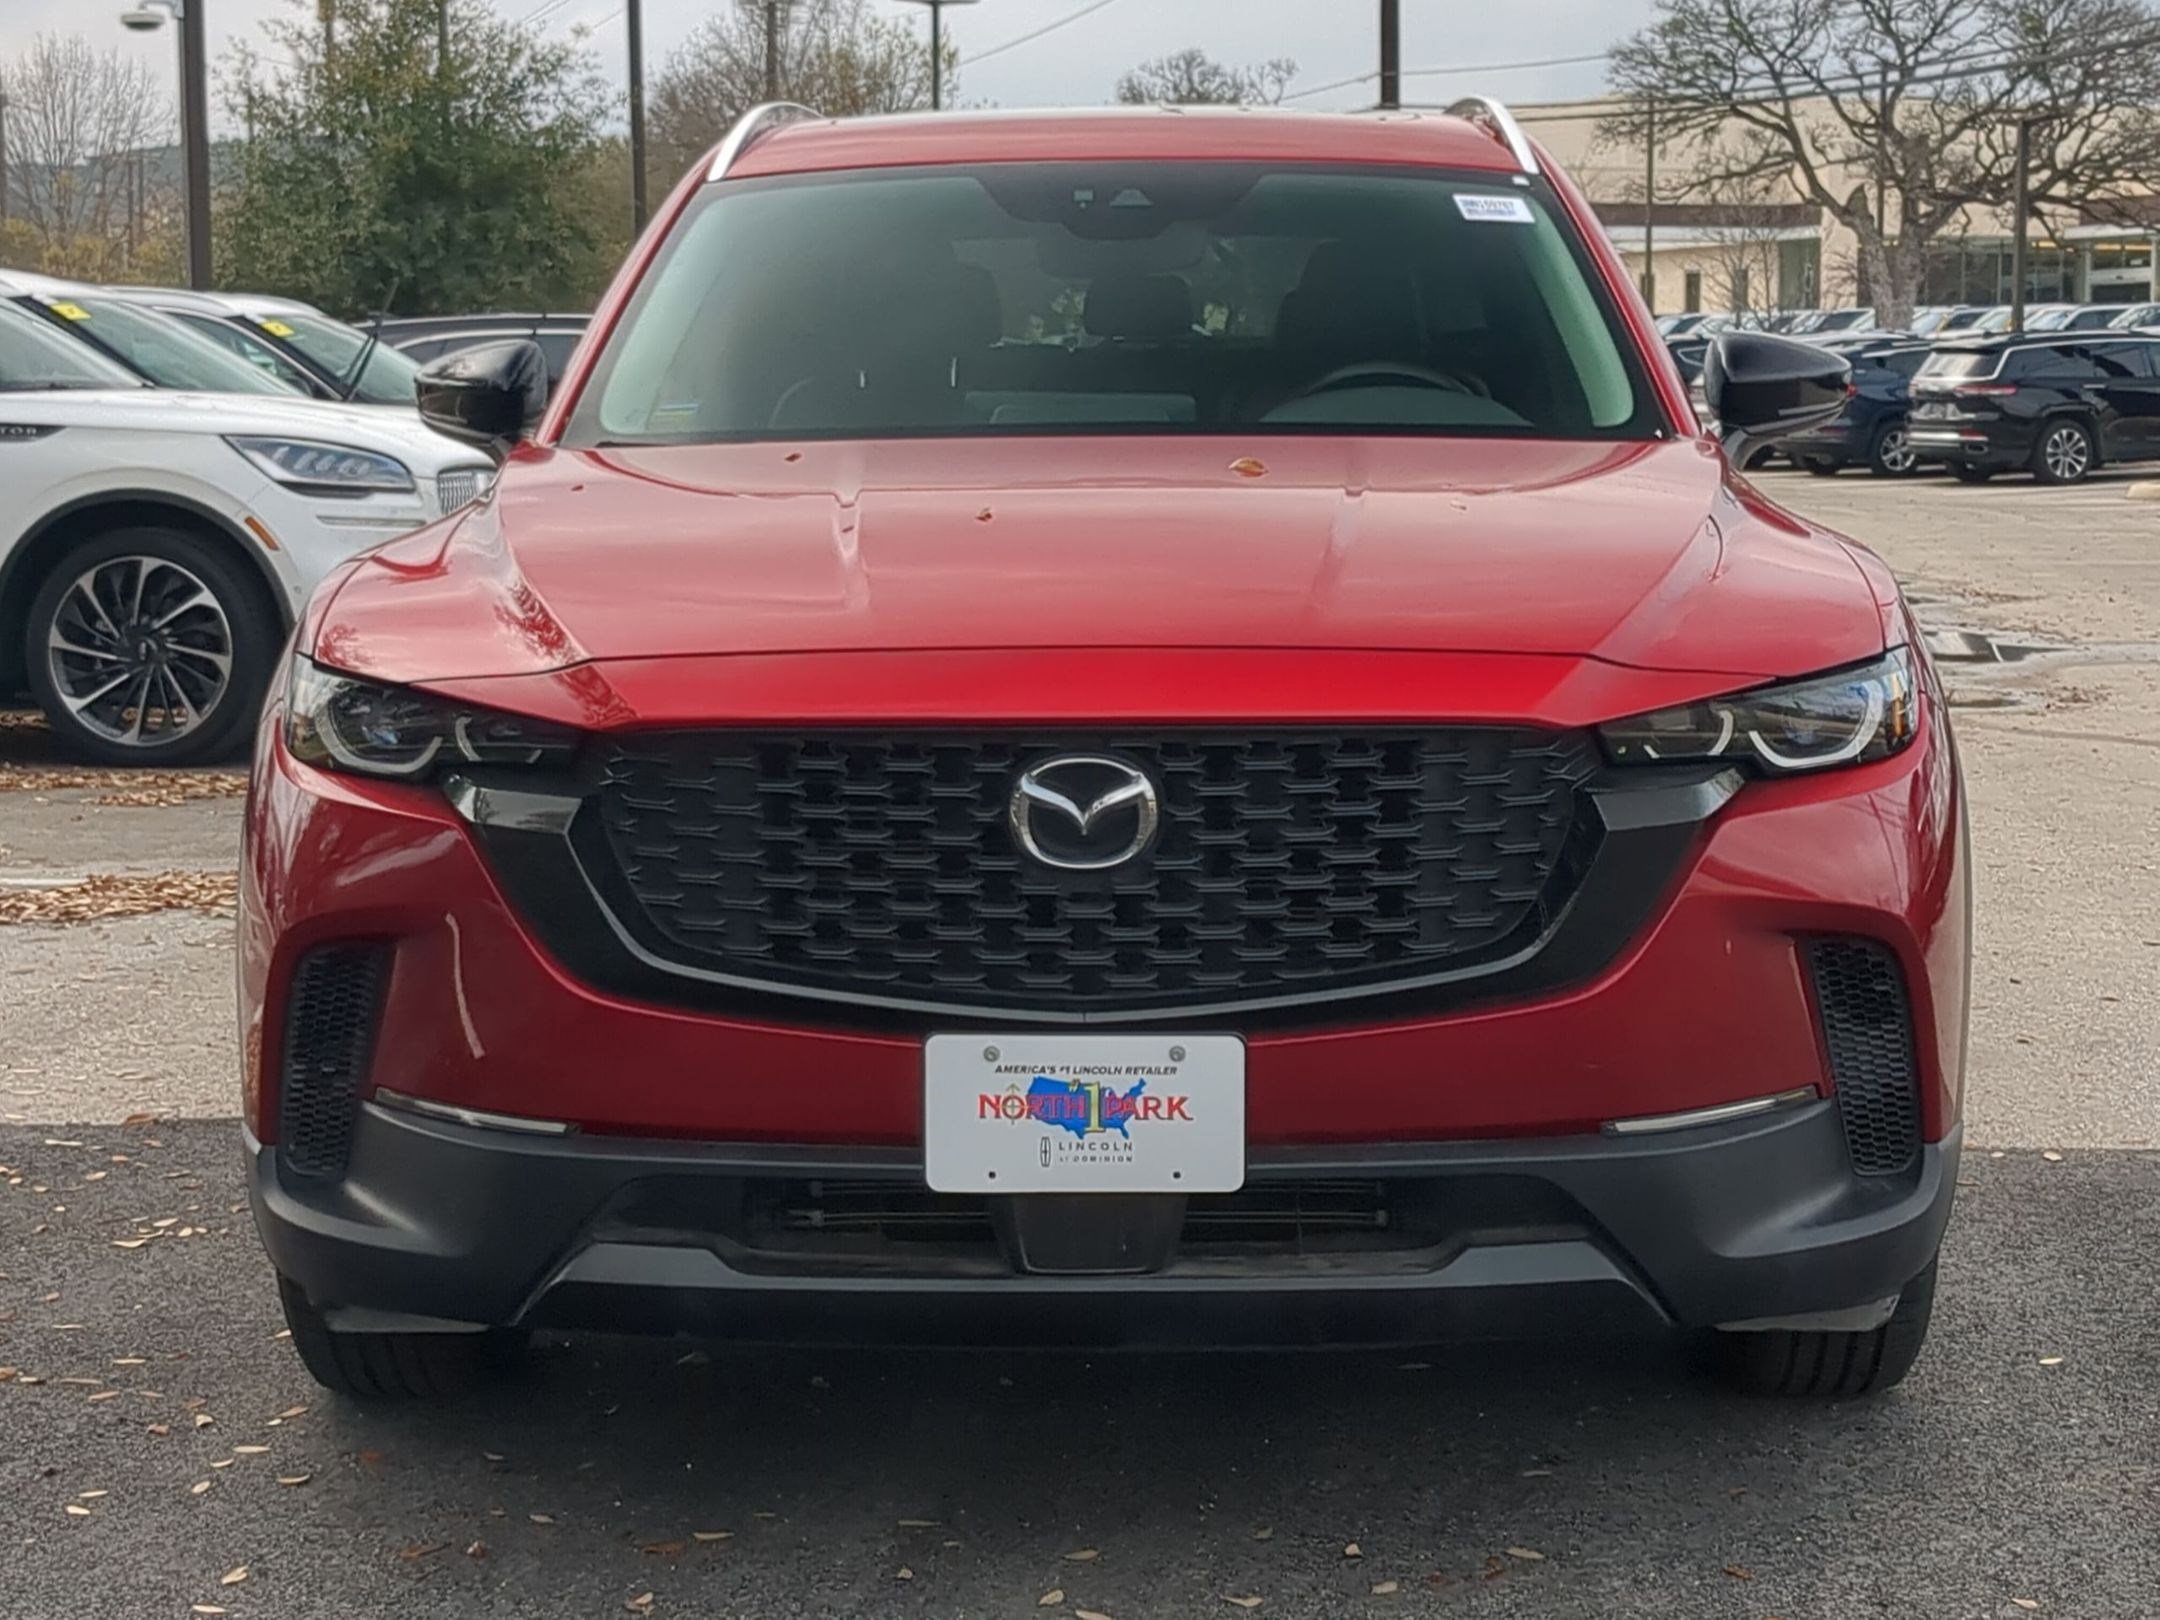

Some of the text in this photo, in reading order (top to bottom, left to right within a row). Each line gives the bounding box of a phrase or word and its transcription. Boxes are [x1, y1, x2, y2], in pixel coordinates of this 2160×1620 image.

[995, 1065, 1056, 1075] AMERICA'S
[1073, 1065, 1122, 1075] LINCOLN
[1125, 1065, 1177, 1075] RETAILER
[979, 1094, 1194, 1120] NORTH PARK
[1058, 1142, 1133, 1152] LINCOLN
[1073, 1155, 1133, 1163] DOMINION
